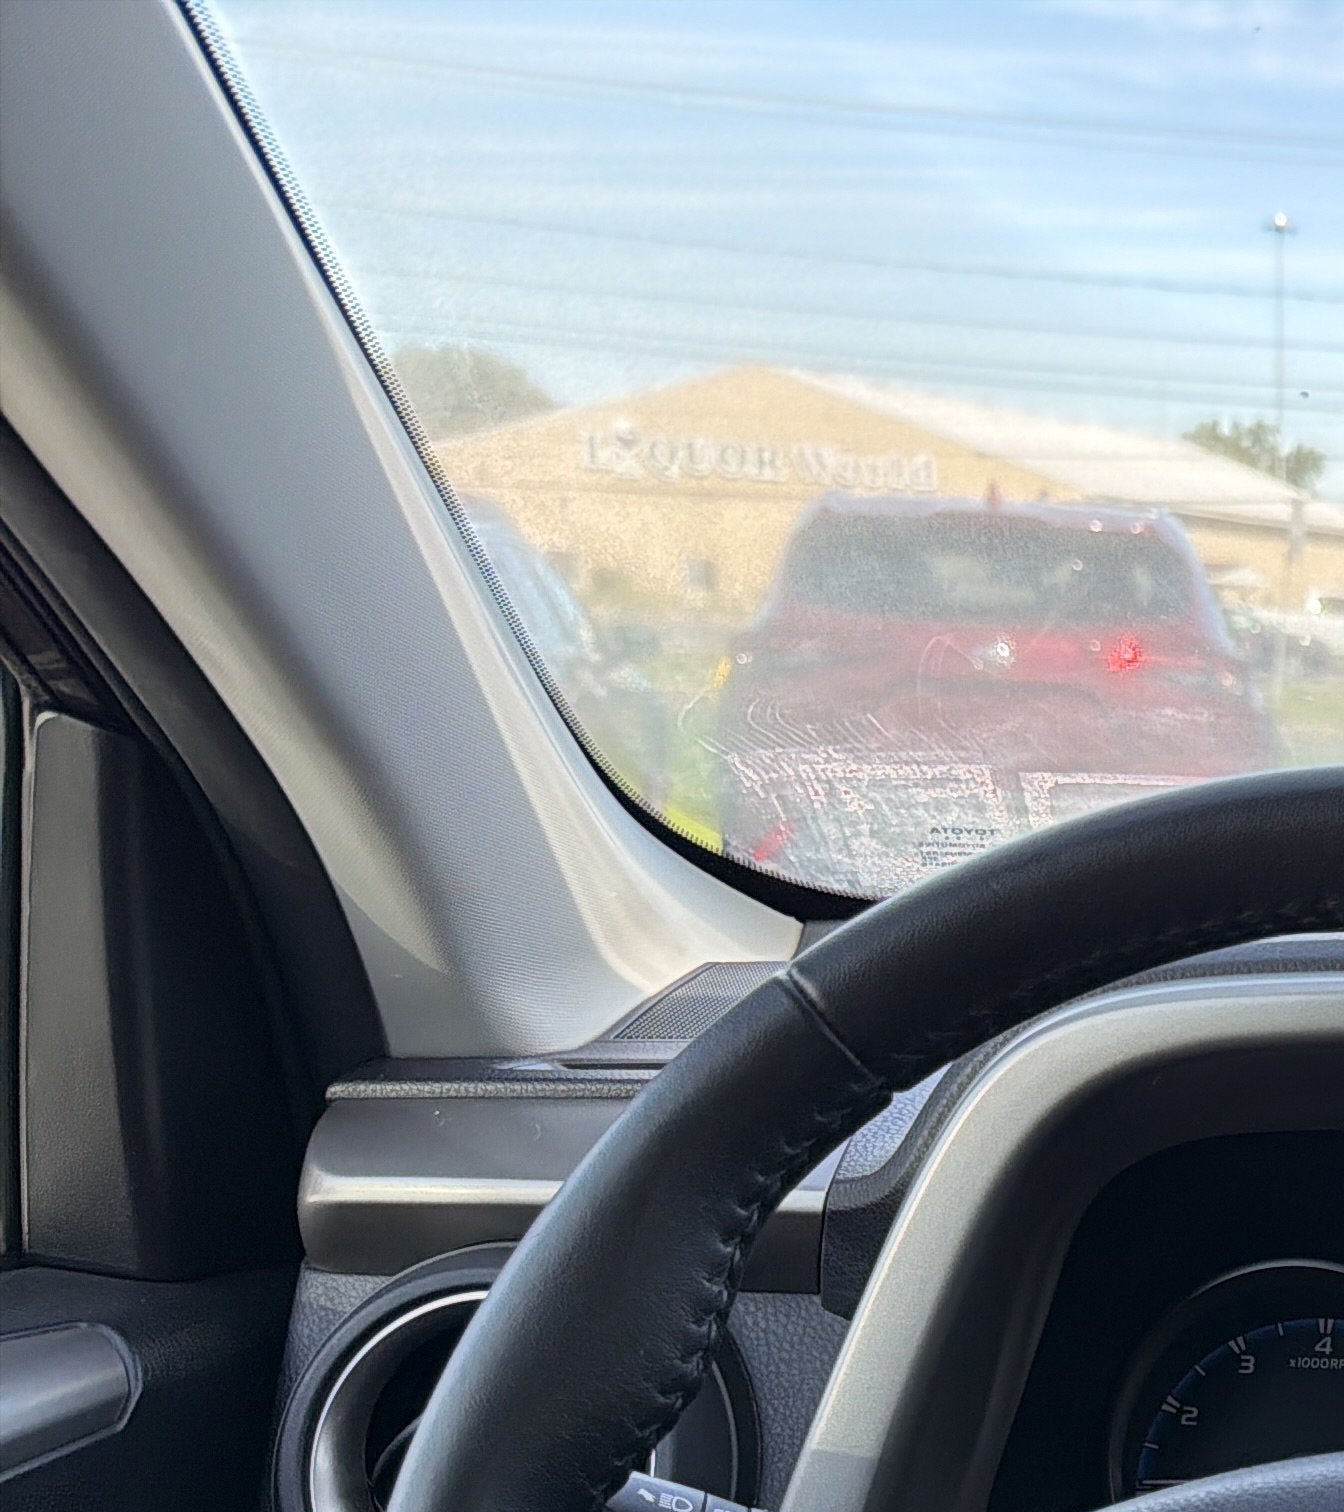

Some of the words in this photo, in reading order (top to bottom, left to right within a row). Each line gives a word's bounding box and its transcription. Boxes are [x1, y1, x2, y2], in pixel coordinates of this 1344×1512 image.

[1315, 1337, 1333, 1355] 4
[1238, 1356, 1255, 1374] 3
[1181, 1406, 1199, 1425] 2
